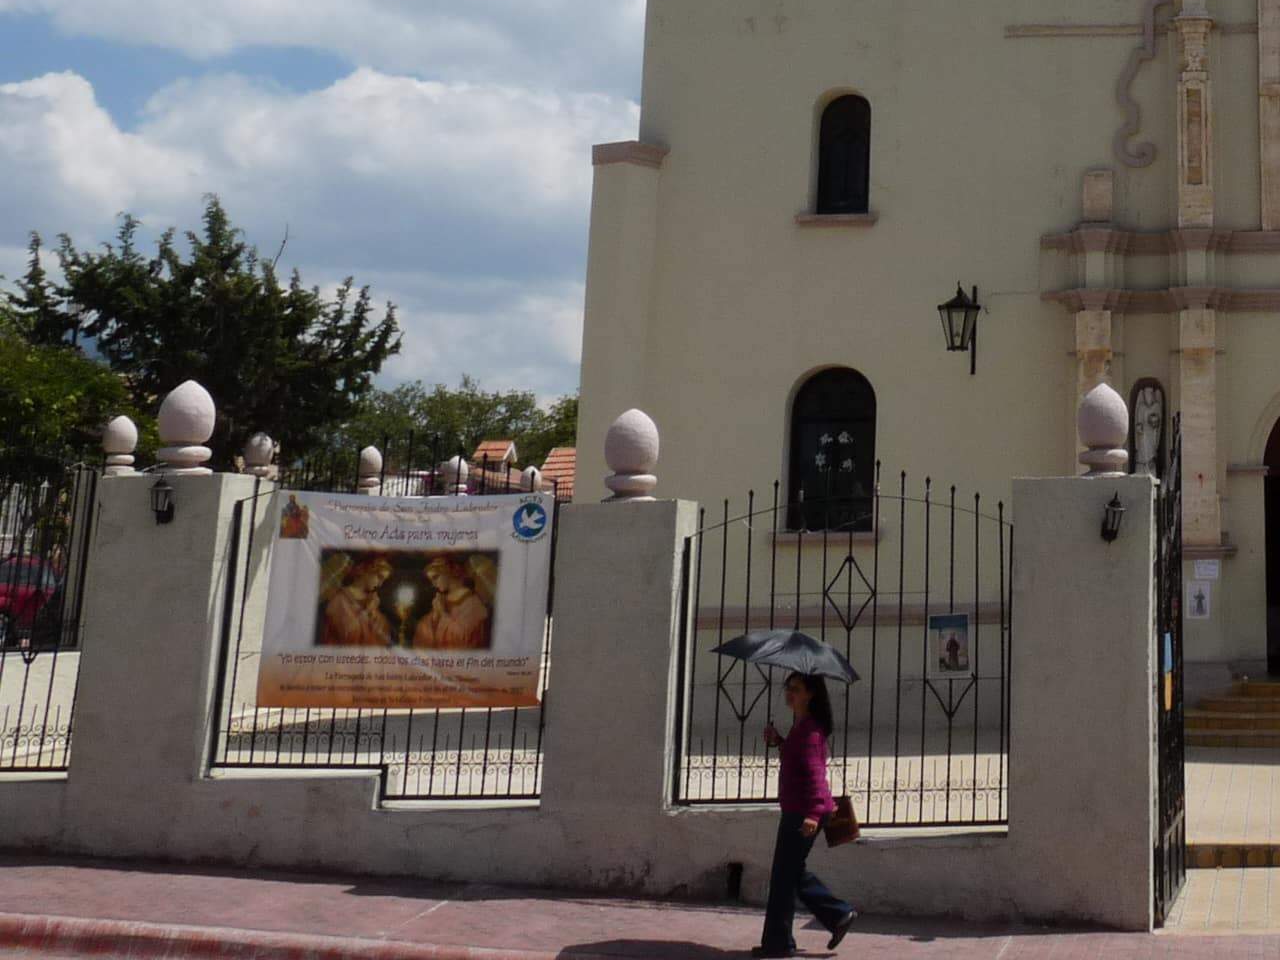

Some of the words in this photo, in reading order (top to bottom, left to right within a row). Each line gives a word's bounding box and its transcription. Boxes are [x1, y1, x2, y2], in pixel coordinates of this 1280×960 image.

[344, 525, 376, 540] Retiro
[406, 527, 433, 543] para
[437, 527, 479, 545] mujeres
[294, 655, 316, 666] estoy
[318, 655, 334, 665] con
[467, 657, 479, 669] fin
[480, 657, 494, 668] del
